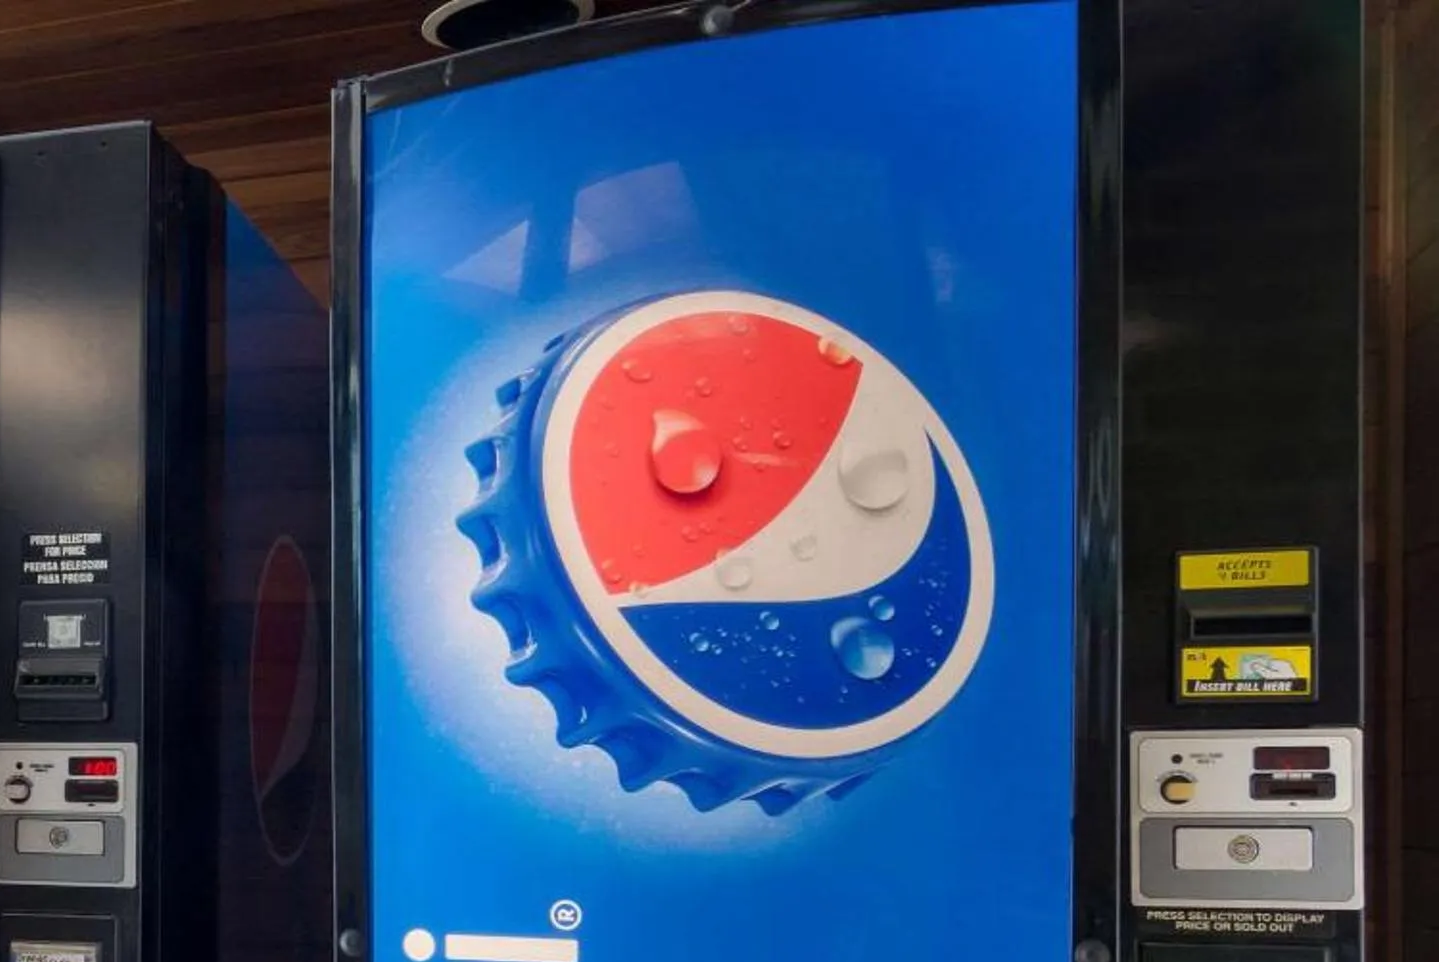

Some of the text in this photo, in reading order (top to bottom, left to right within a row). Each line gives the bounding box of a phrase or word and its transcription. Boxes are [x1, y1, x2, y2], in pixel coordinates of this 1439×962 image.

[29, 533, 102, 546] PRESS SELECTION
[1235, 681, 1260, 692] BILL
[1262, 681, 1293, 692] HERE
[1147, 911, 1325, 923] PRESS SELECTION TO DISPLAY
[1176, 921, 1294, 932] PRICE OR SOLD OUT
